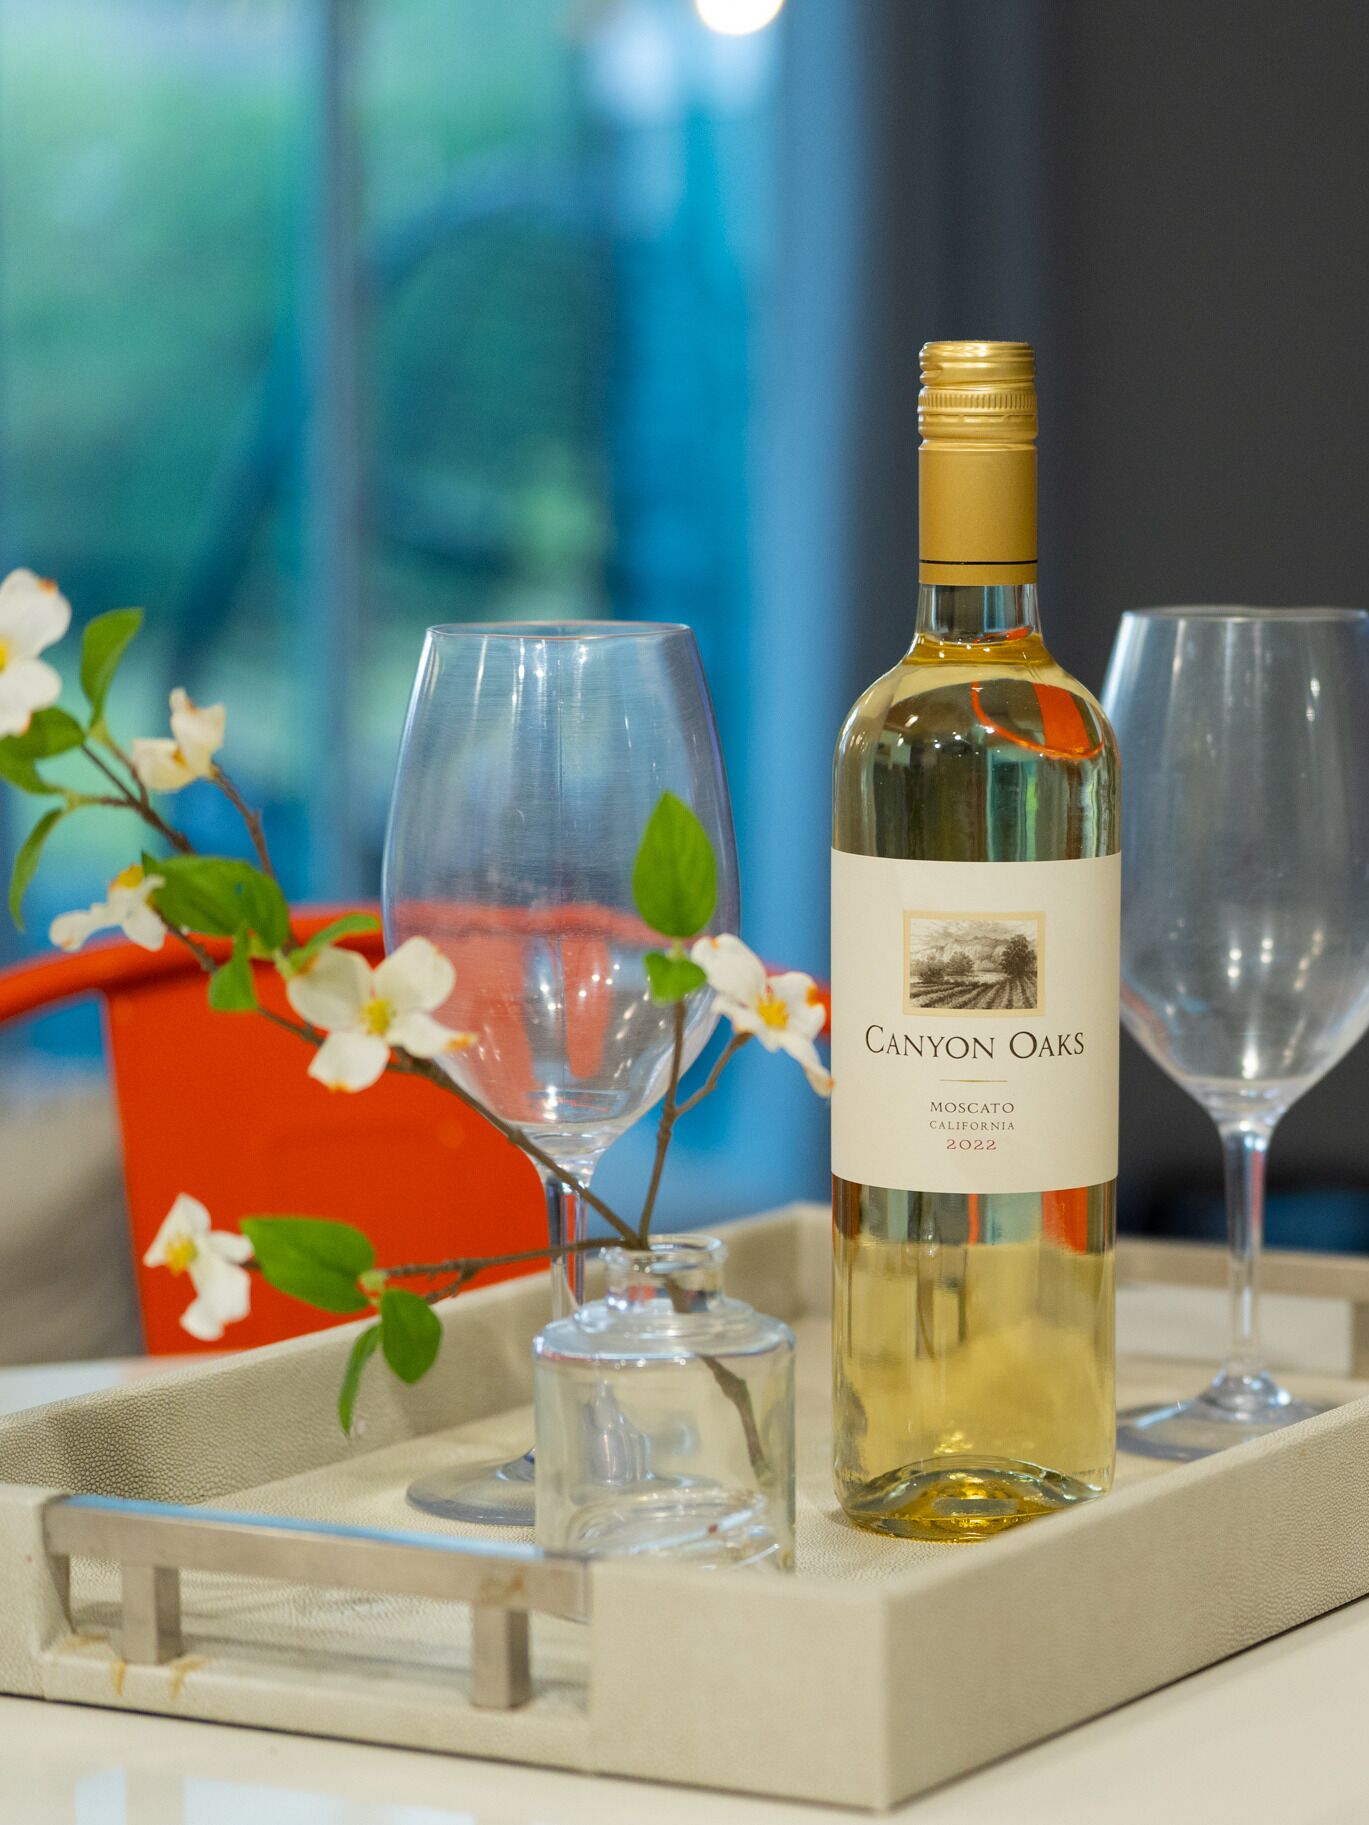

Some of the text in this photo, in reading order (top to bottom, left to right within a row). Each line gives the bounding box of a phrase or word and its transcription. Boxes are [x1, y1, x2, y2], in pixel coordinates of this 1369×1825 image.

[864, 1024, 1086, 1060] CANYON OAKS
[929, 1101, 1015, 1115] MOSCATO
[929, 1120, 1016, 1132] CALIFORNIA
[945, 1138, 998, 1152] 2022
